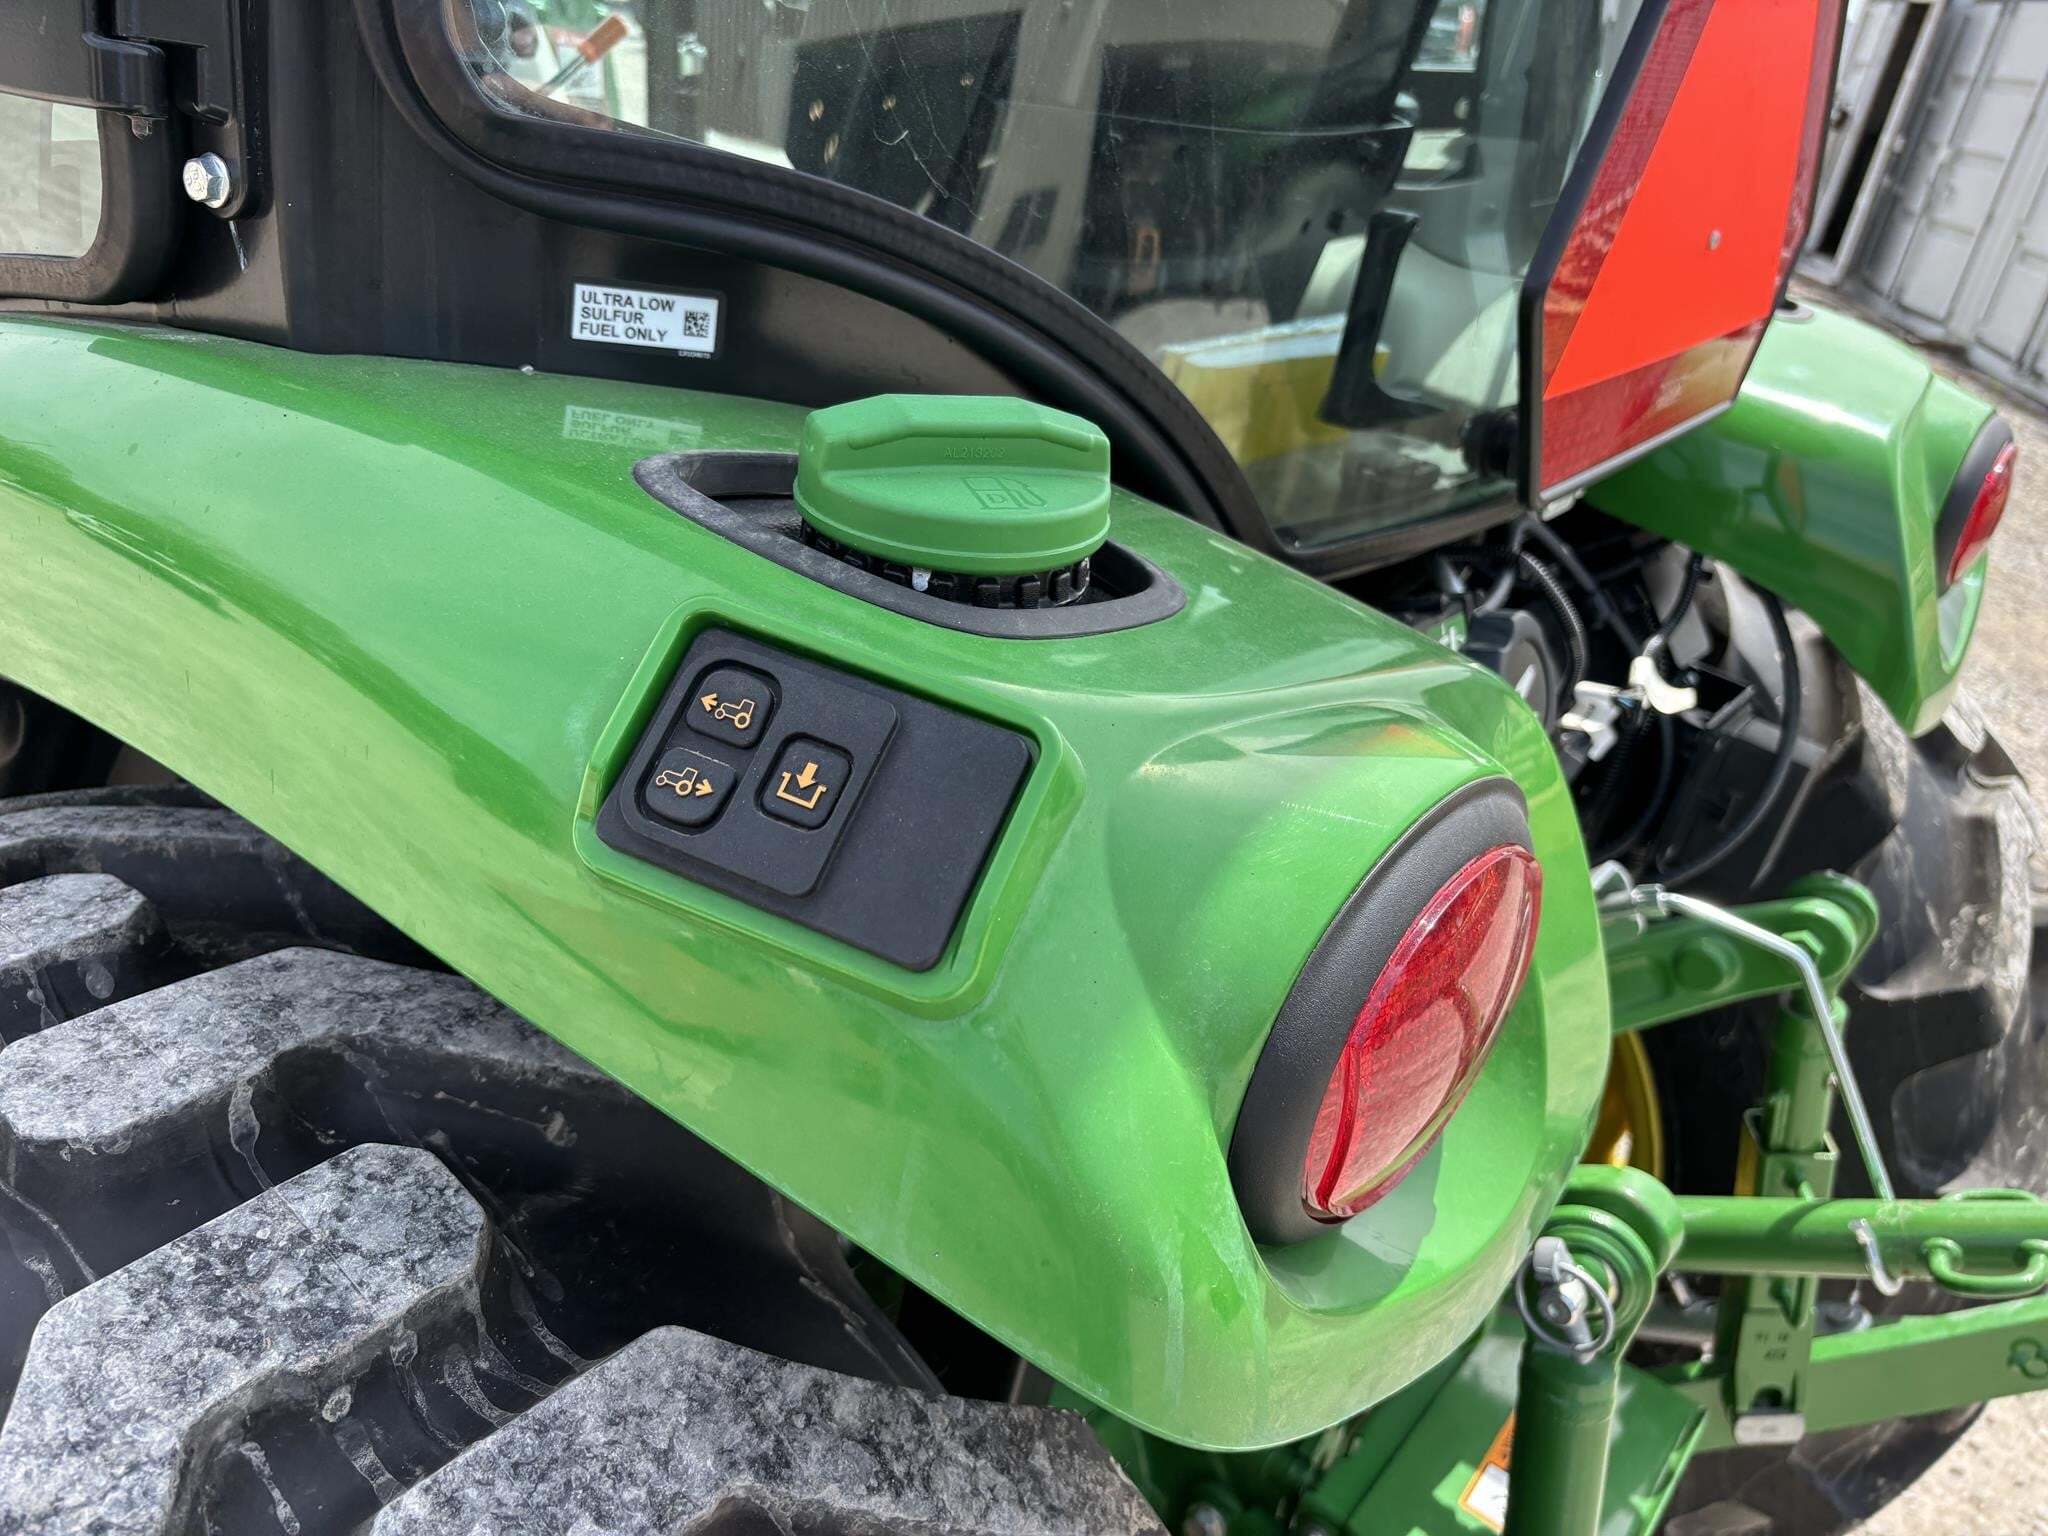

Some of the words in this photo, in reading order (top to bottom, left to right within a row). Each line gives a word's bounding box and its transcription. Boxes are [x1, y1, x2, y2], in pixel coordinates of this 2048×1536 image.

[581, 290, 634, 308] ULTRA
[639, 297, 675, 312] LOW
[580, 306, 645, 325] SULFUR
[579, 321, 620, 338] FUEL
[625, 326, 669, 342] ONLY
